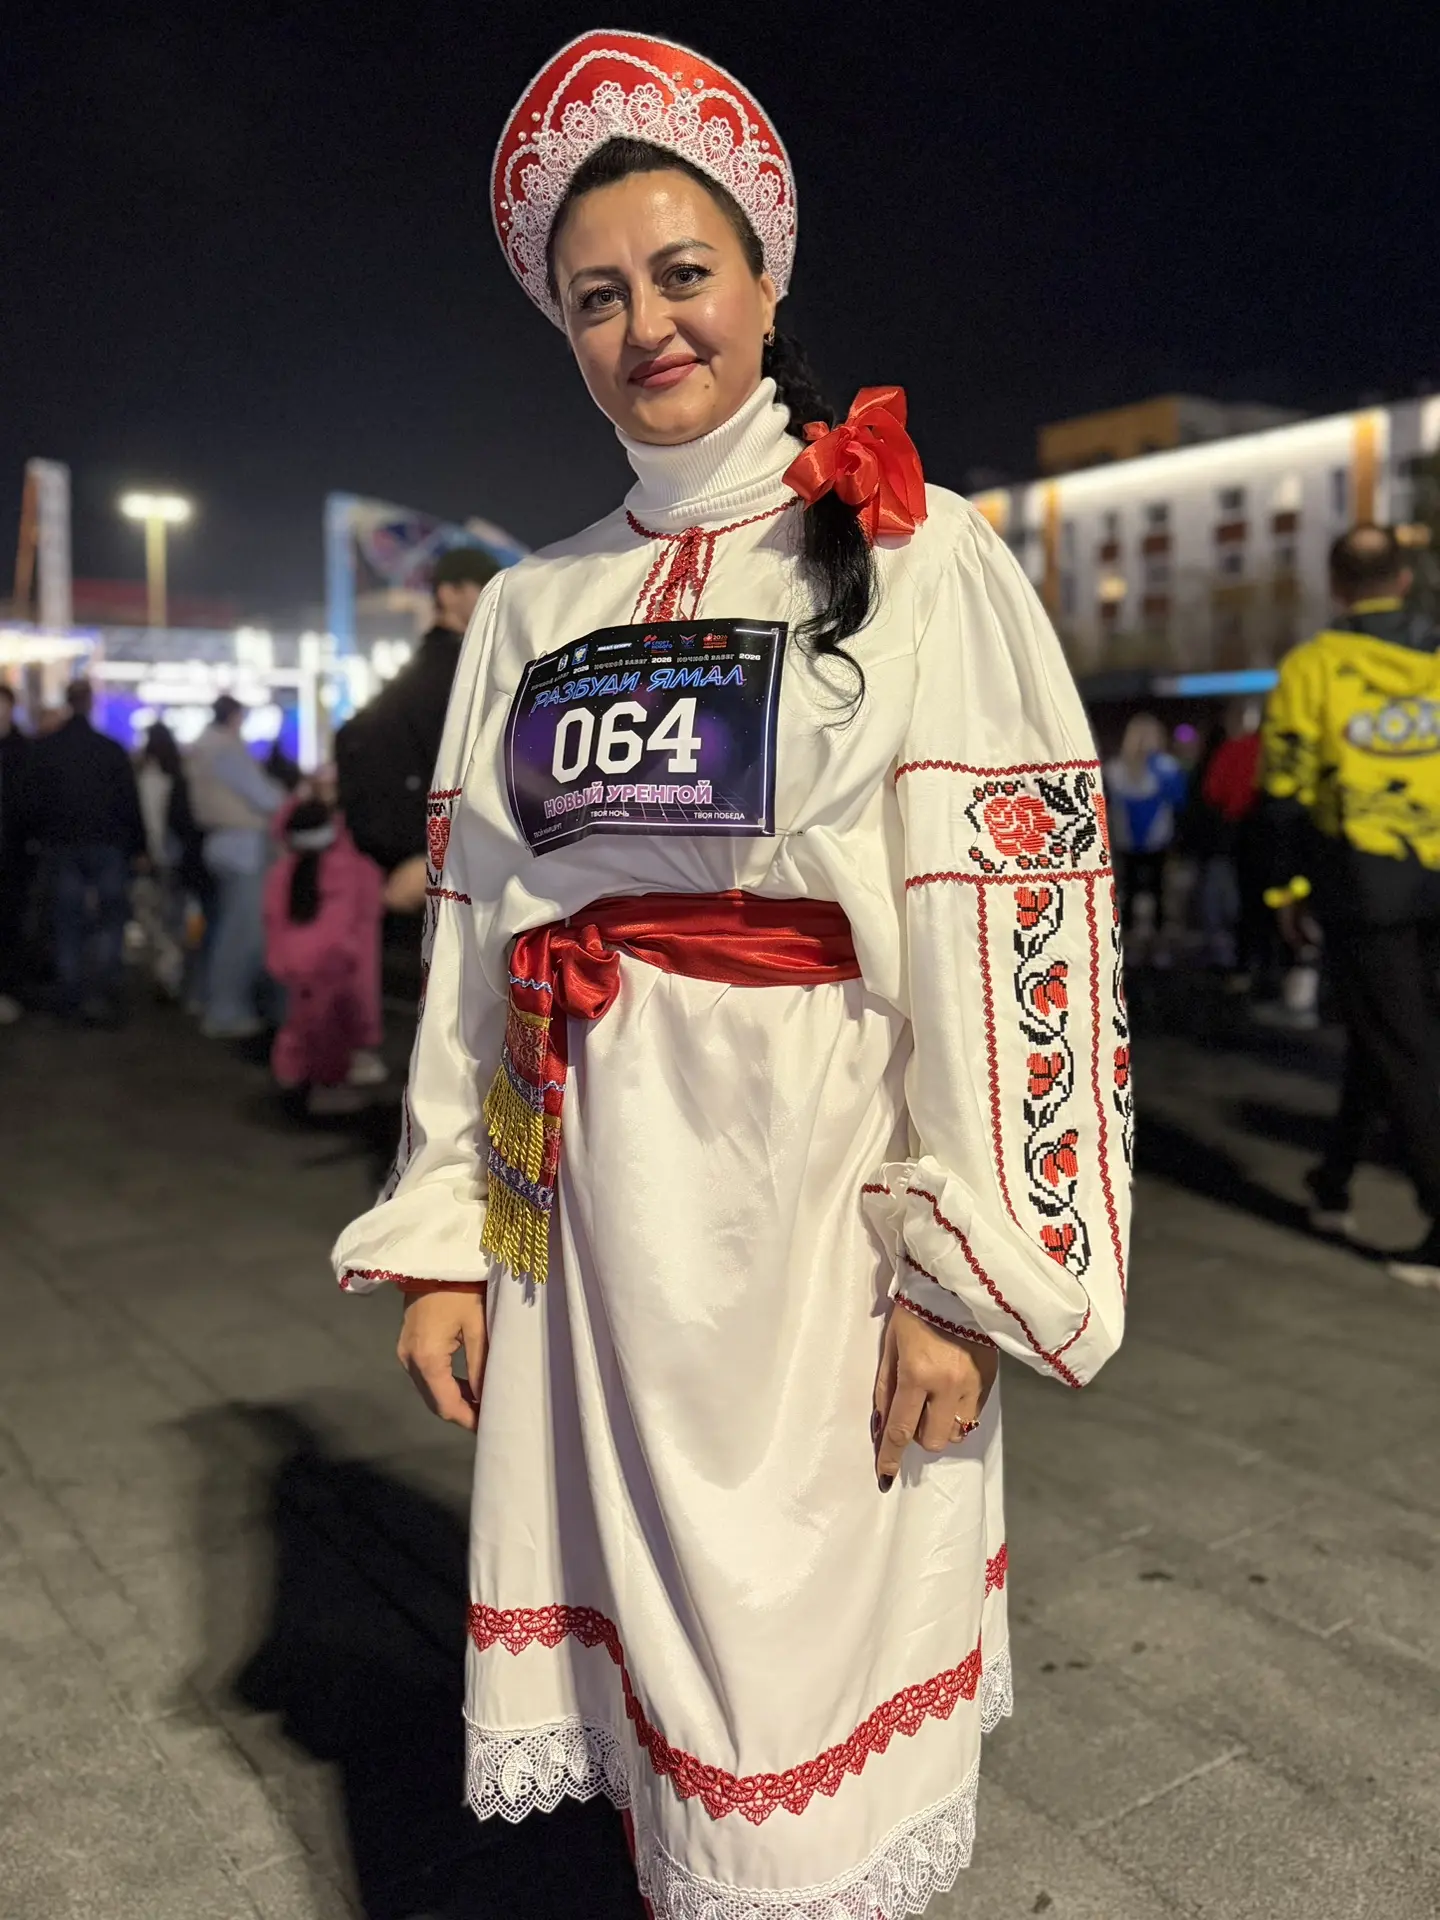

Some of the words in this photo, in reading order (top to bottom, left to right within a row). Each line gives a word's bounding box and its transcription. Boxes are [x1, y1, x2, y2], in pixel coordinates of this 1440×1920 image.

[530, 671, 641, 714] РАЗБУДИ
[646, 664, 747, 692] ЯМАЛ
[552, 698, 701, 783] 064
[543, 781, 604, 819] НОВЫЙ
[606, 780, 712, 804] УРЕНГОЙ
[609, 809, 629, 817] НОЧЬ
[714, 812, 745, 820] ПОБЕДА
